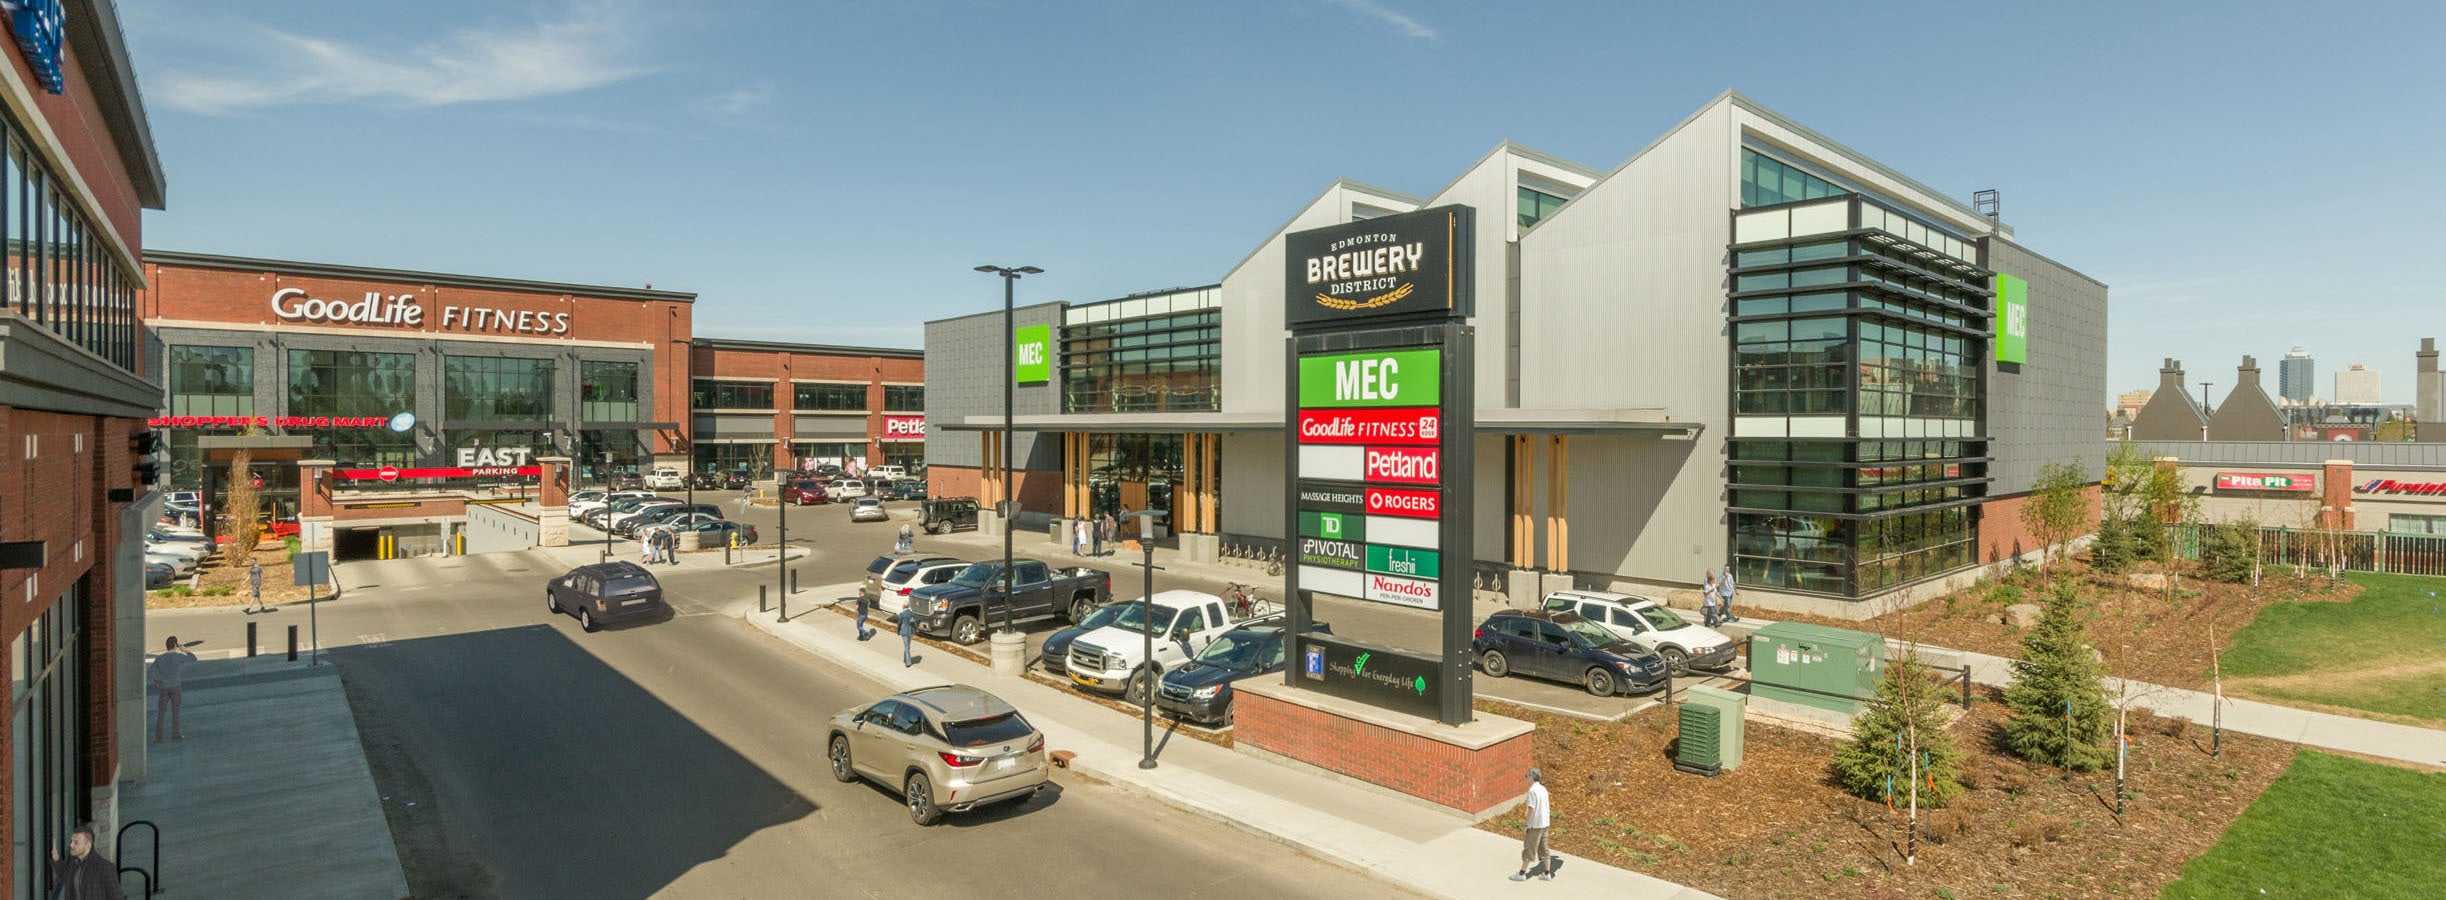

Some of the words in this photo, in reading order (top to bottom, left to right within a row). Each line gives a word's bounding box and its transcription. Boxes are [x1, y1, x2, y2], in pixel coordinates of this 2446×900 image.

[1331, 234, 1397, 251] EDMONTON
[1307, 242, 1423, 283] BREWERY
[1331, 277, 1397, 295] DISTRICT
[271, 287, 422, 325] GoodLife
[442, 306, 568, 333] FITNESS
[2007, 302, 2025, 338] MEC
[1019, 341, 1043, 366] MEC
[1335, 357, 1399, 401] MEC
[147, 415, 270, 427] SHOPPERS
[274, 416, 330, 427] DRUG
[334, 417, 388, 427] MART
[1302, 416, 1356, 437] GoodLife
[1358, 422, 1416, 437] FITNESS
[1422, 419, 1435, 429] 24
[457, 447, 531, 467] EAST
[1368, 451, 1437, 479] Petland
[2231, 475, 2261, 486] Pita
[2264, 476, 2287, 487] Pit
[1301, 492, 1331, 502] MASSAGE
[1332, 493, 1364, 504] HEIGHTS
[1385, 495, 1435, 510] ROGERS
[1322, 516, 1340, 533] TD
[1303, 539, 1359, 560] PIVOTAL
[1303, 554, 1359, 568] PHYSIOTHERAPY
[1388, 548, 1416, 574] freshii
[1373, 575, 1432, 597] Nando's
[1329, 662, 1356, 679] Shopping
[1361, 668, 1372, 678] for
[1372, 670, 1401, 688] Everyday
[1401, 676, 1414, 690] Life
